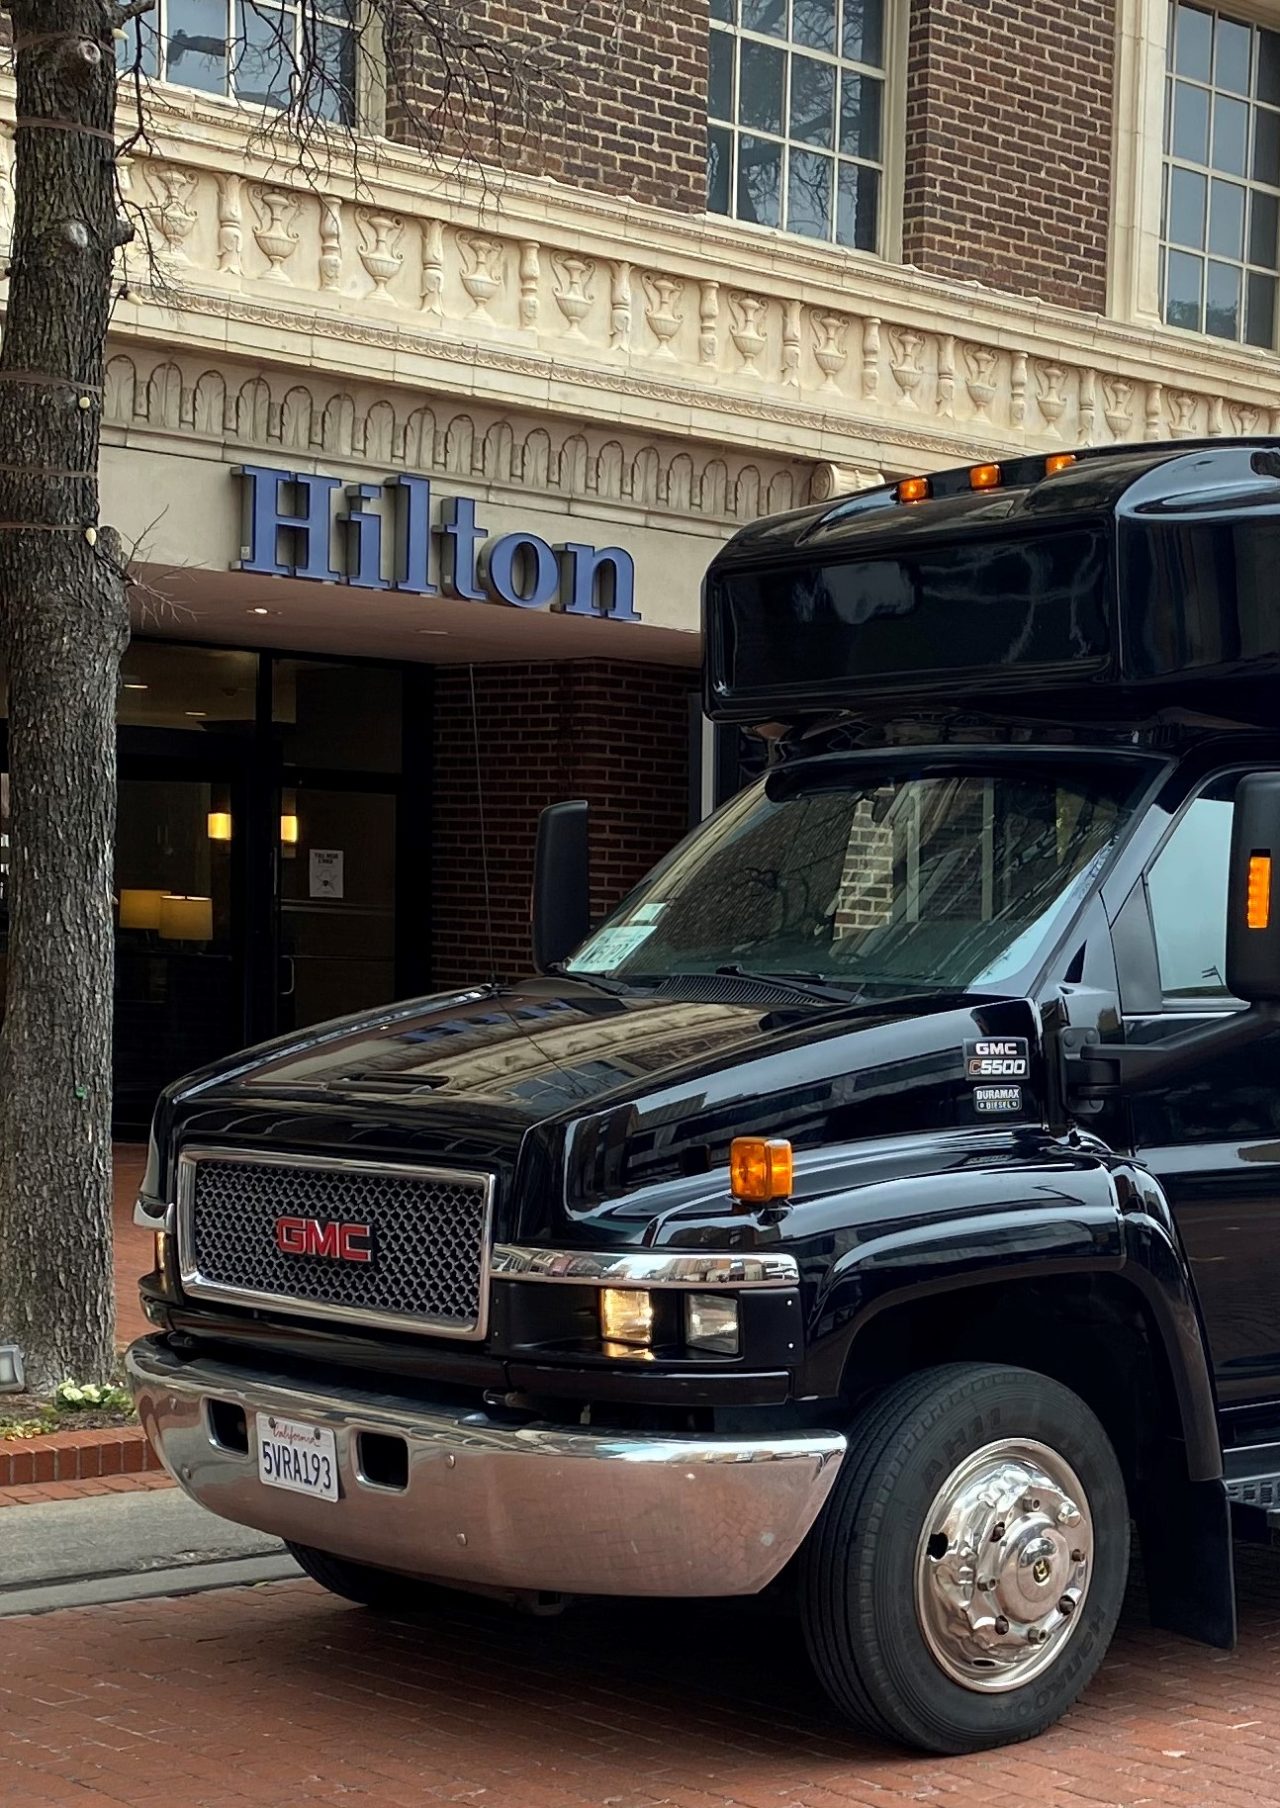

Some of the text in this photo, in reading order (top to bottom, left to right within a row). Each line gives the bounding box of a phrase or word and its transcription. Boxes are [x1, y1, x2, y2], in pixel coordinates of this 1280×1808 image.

[234, 464, 642, 622] Hilton
[975, 1042, 1018, 1055] GMC
[968, 1059, 1026, 1075] C5500
[976, 1088, 1020, 1100] DURAMAX
[985, 1100, 1011, 1110] DIESEL
[275, 1215, 372, 1263] GMC
[272, 1421, 321, 1447] California
[262, 1440, 332, 1490] 5VRA193
